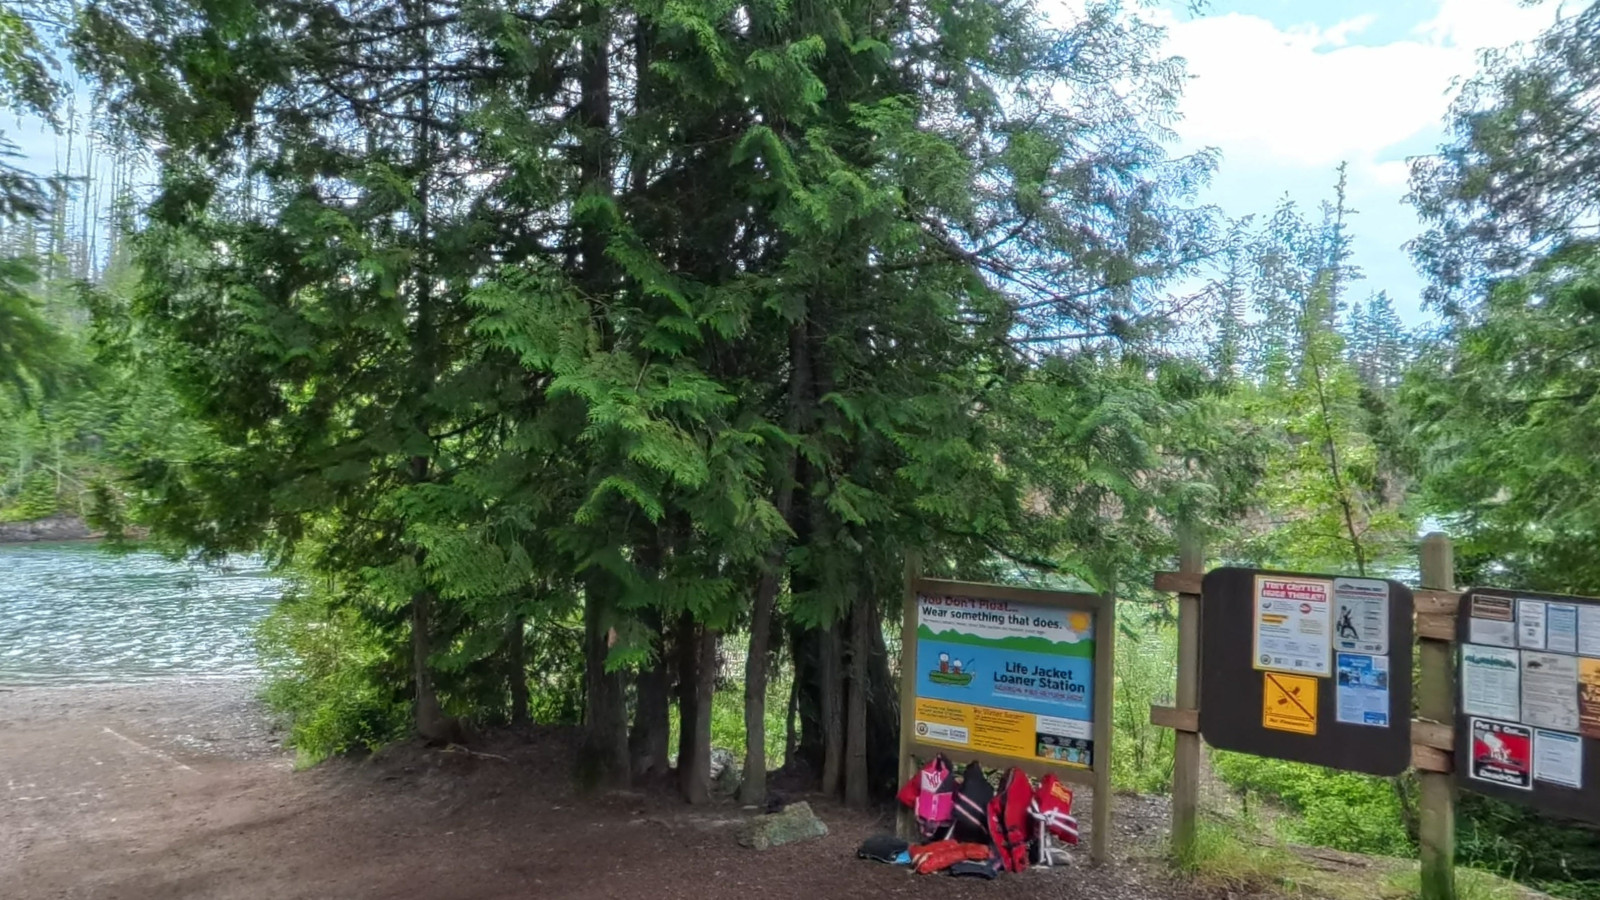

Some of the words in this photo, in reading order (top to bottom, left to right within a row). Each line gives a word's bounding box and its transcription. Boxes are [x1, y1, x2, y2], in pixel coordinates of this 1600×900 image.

[922, 606, 948, 617] Wear
[951, 609, 1005, 625] something
[1008, 614, 1029, 626] that
[1033, 617, 1062, 629] does.
[1006, 661, 1028, 674] Life
[1032, 666, 1073, 680] Jacket
[993, 671, 1036, 686] Loaner
[1039, 678, 1085, 693] Station
